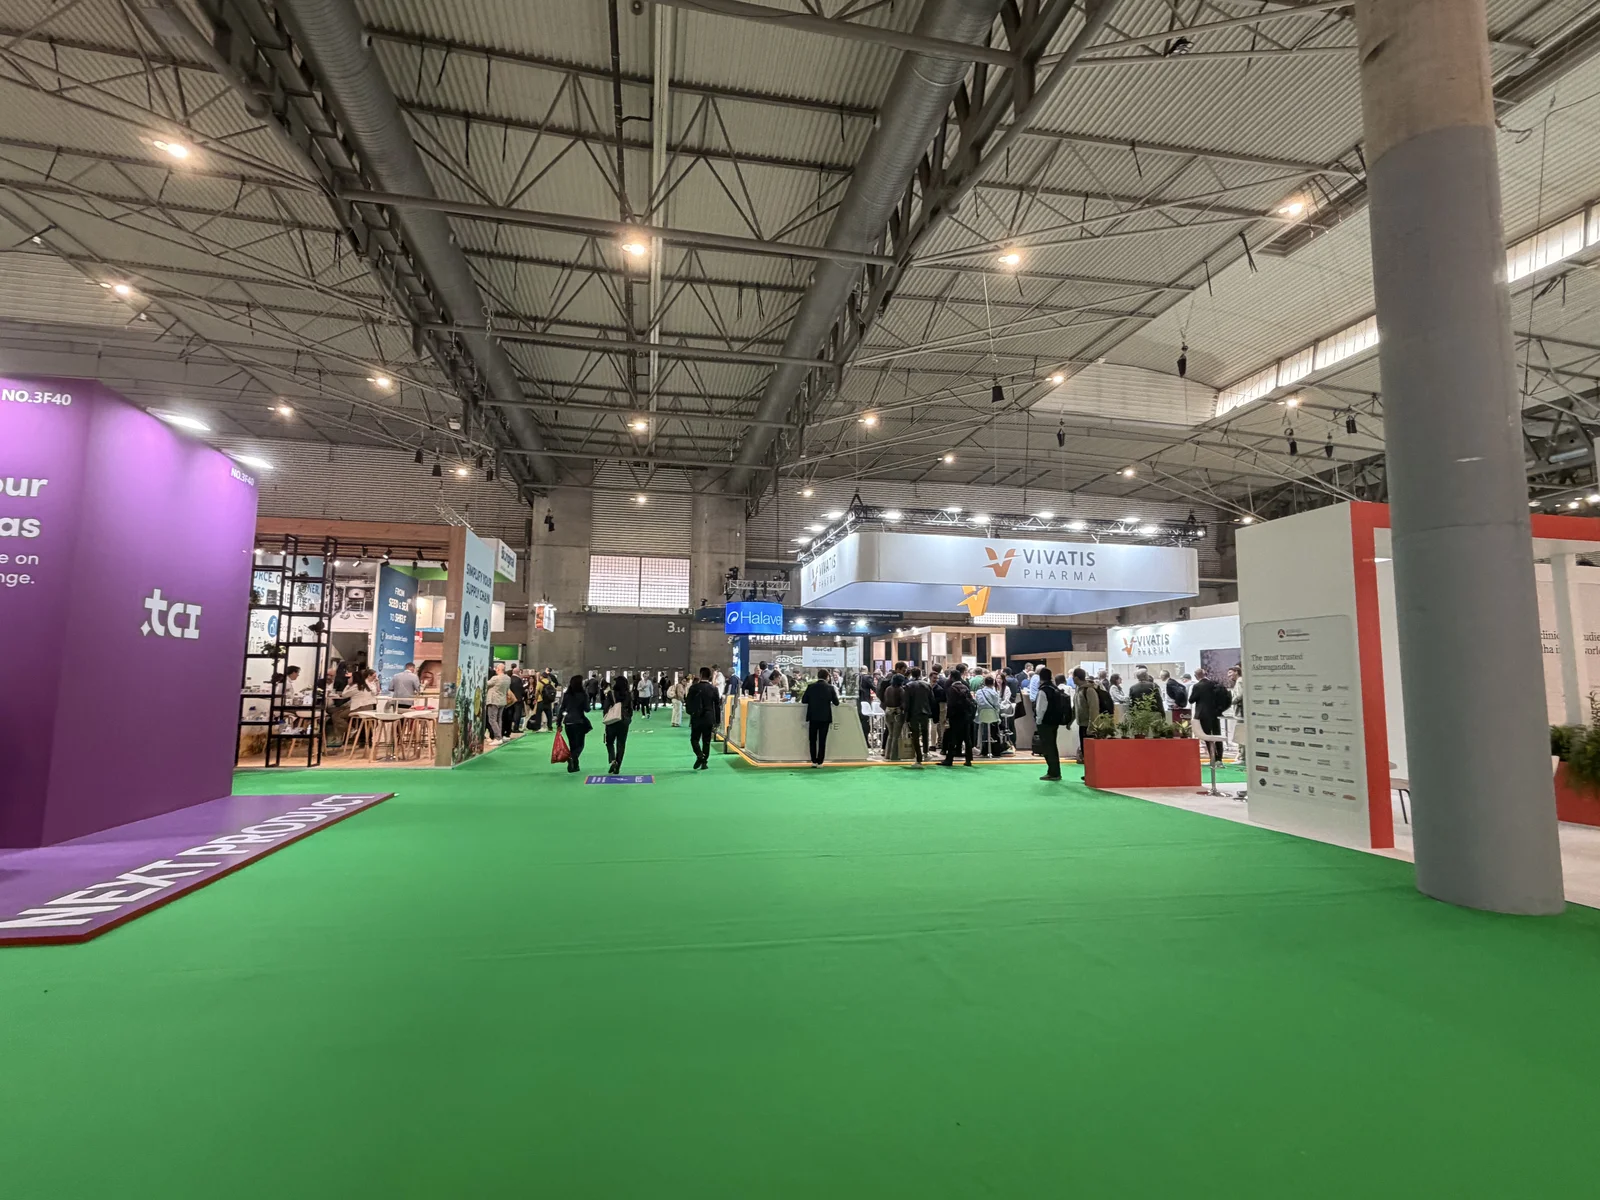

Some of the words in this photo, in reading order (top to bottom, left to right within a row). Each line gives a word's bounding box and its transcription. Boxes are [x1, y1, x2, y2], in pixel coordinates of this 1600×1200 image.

[1, 389, 72, 406] NO.3F40
[0, 477, 48, 497] ur
[15, 554, 39, 565] on
[1022, 549, 1096, 566] VIVATIS
[1023, 568, 1096, 581] PHARMA
[466, 582, 479, 599] SUPPLY
[667, 621, 686, 633] 3.14
[1137, 634, 1170, 646] VIVATIS
[0, 860, 222, 928] NEXT
[176, 794, 376, 857] PRODUCT
